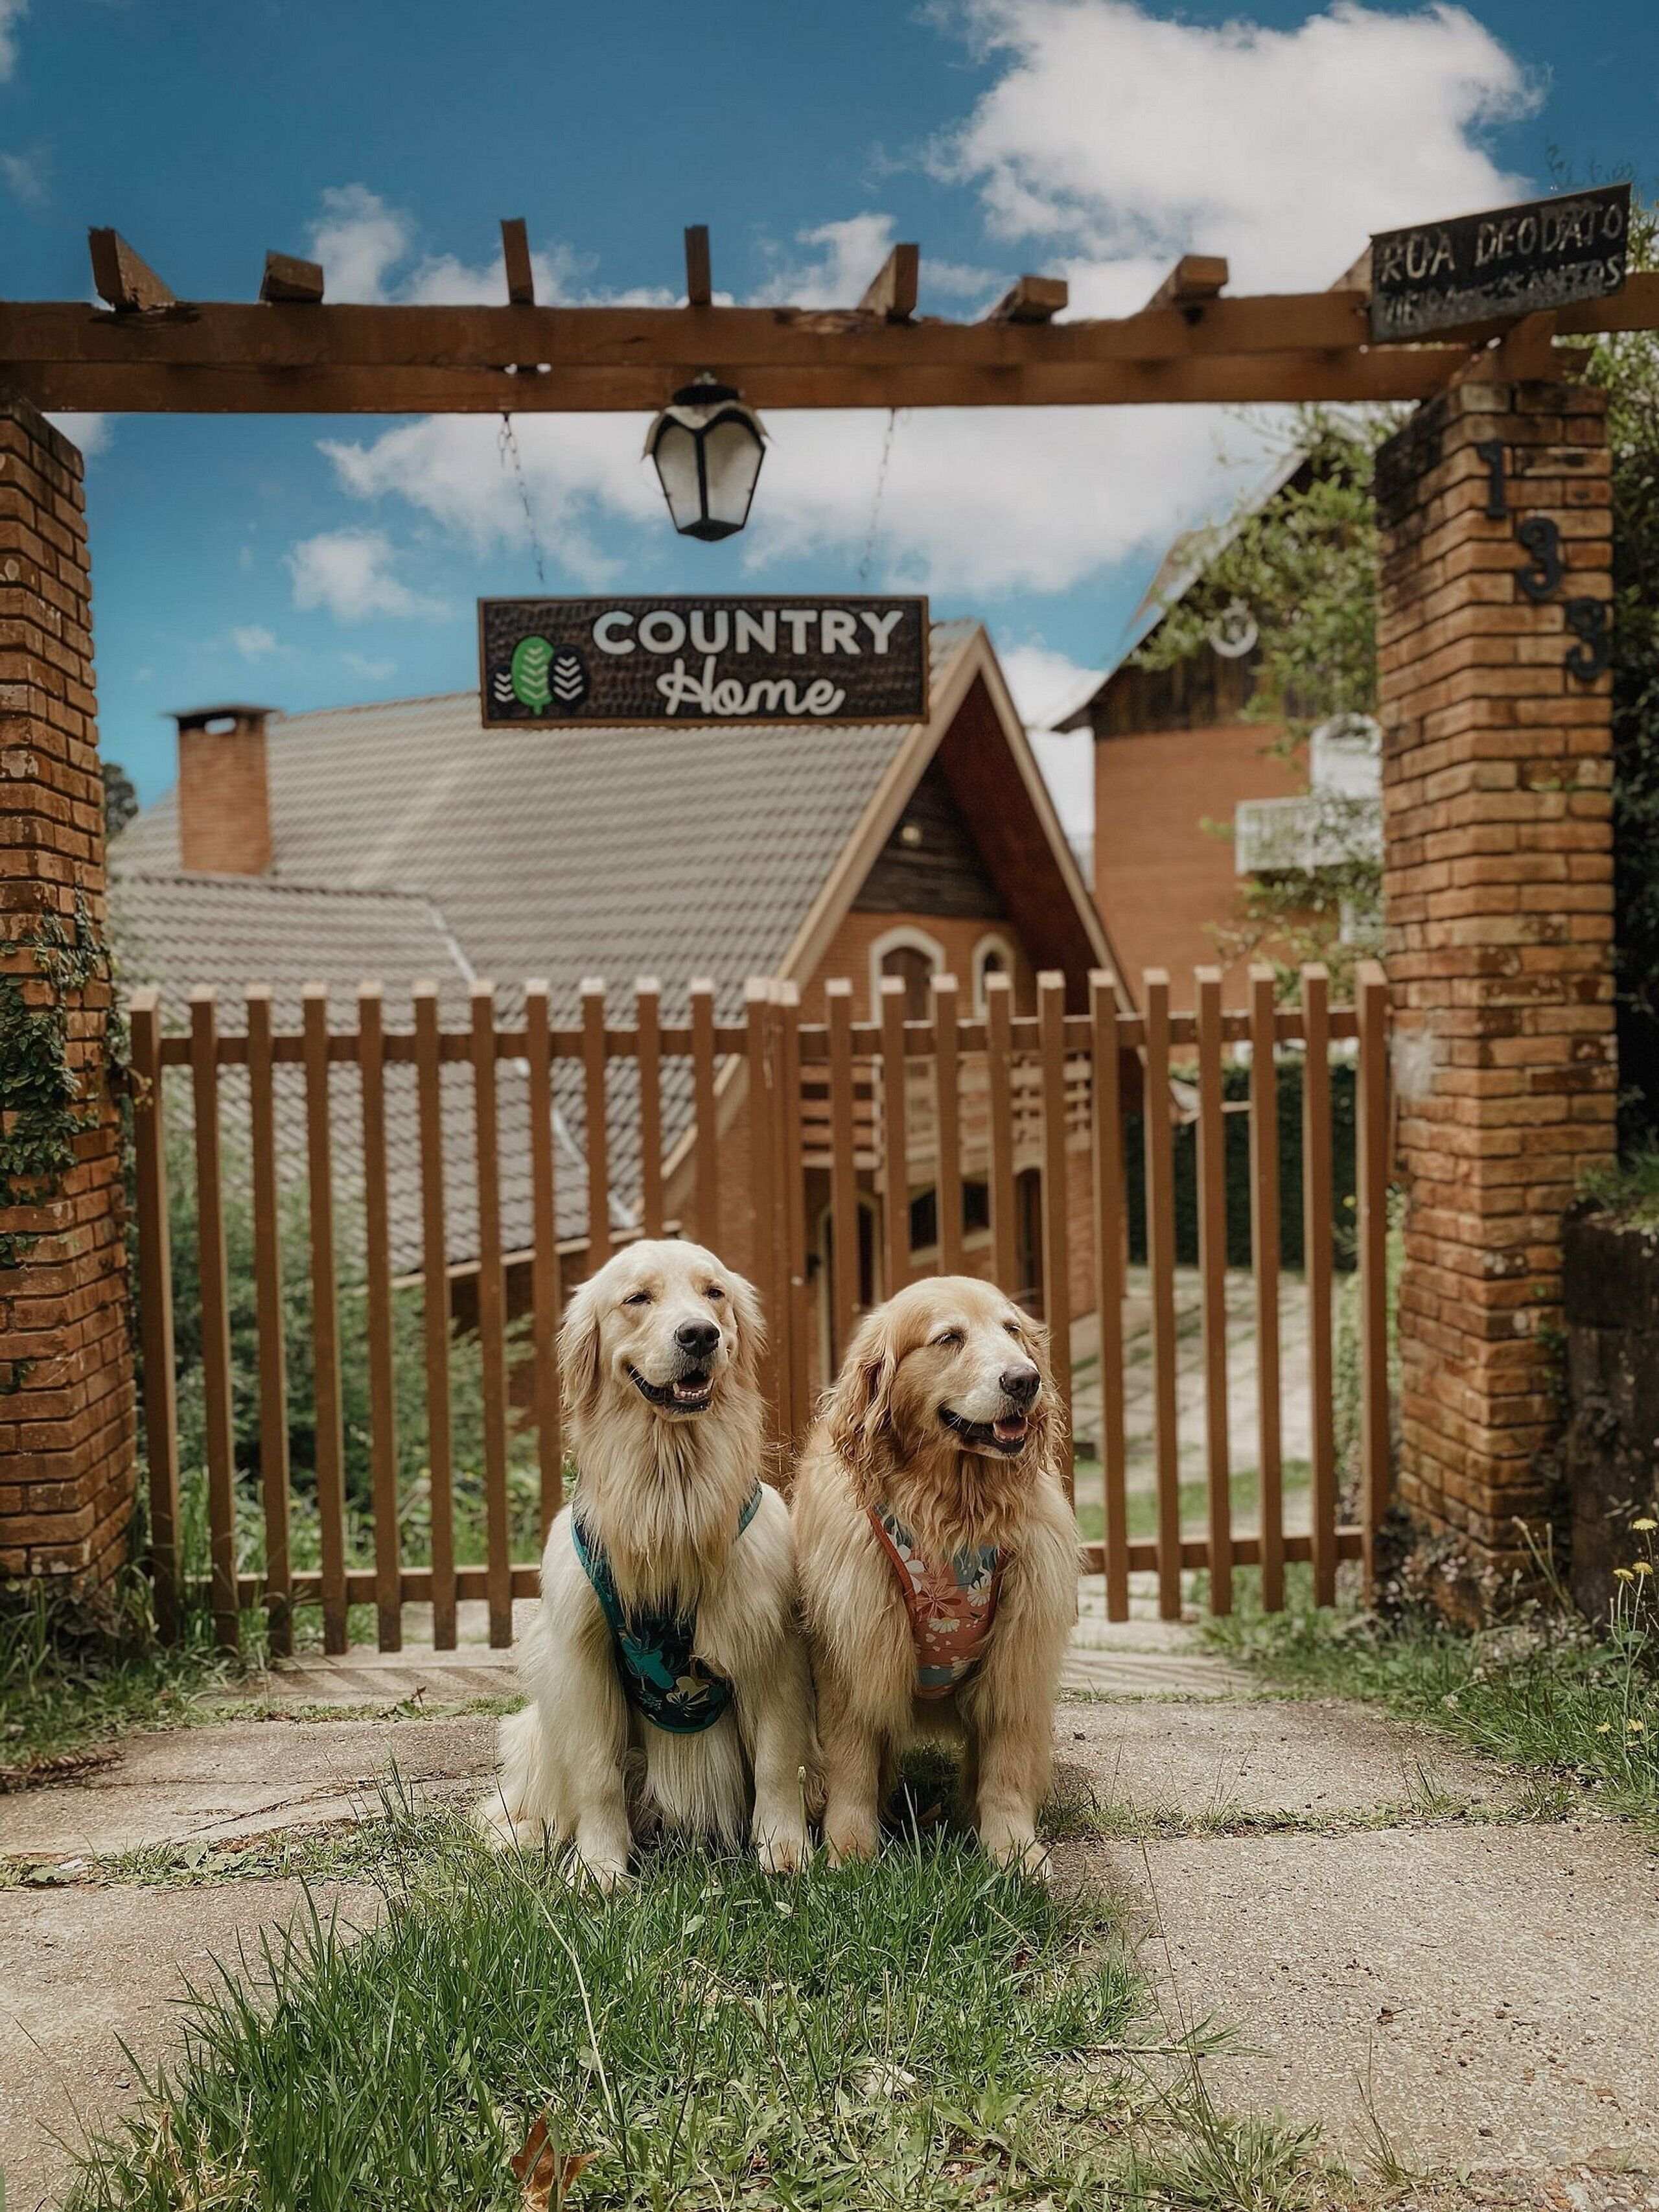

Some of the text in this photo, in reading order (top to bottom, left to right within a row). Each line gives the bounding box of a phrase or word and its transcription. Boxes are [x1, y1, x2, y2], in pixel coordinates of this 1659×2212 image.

[1381, 229, 1456, 283] RUA
[592, 609, 904, 655] COUNTRY
[656, 655, 846, 716] Home
